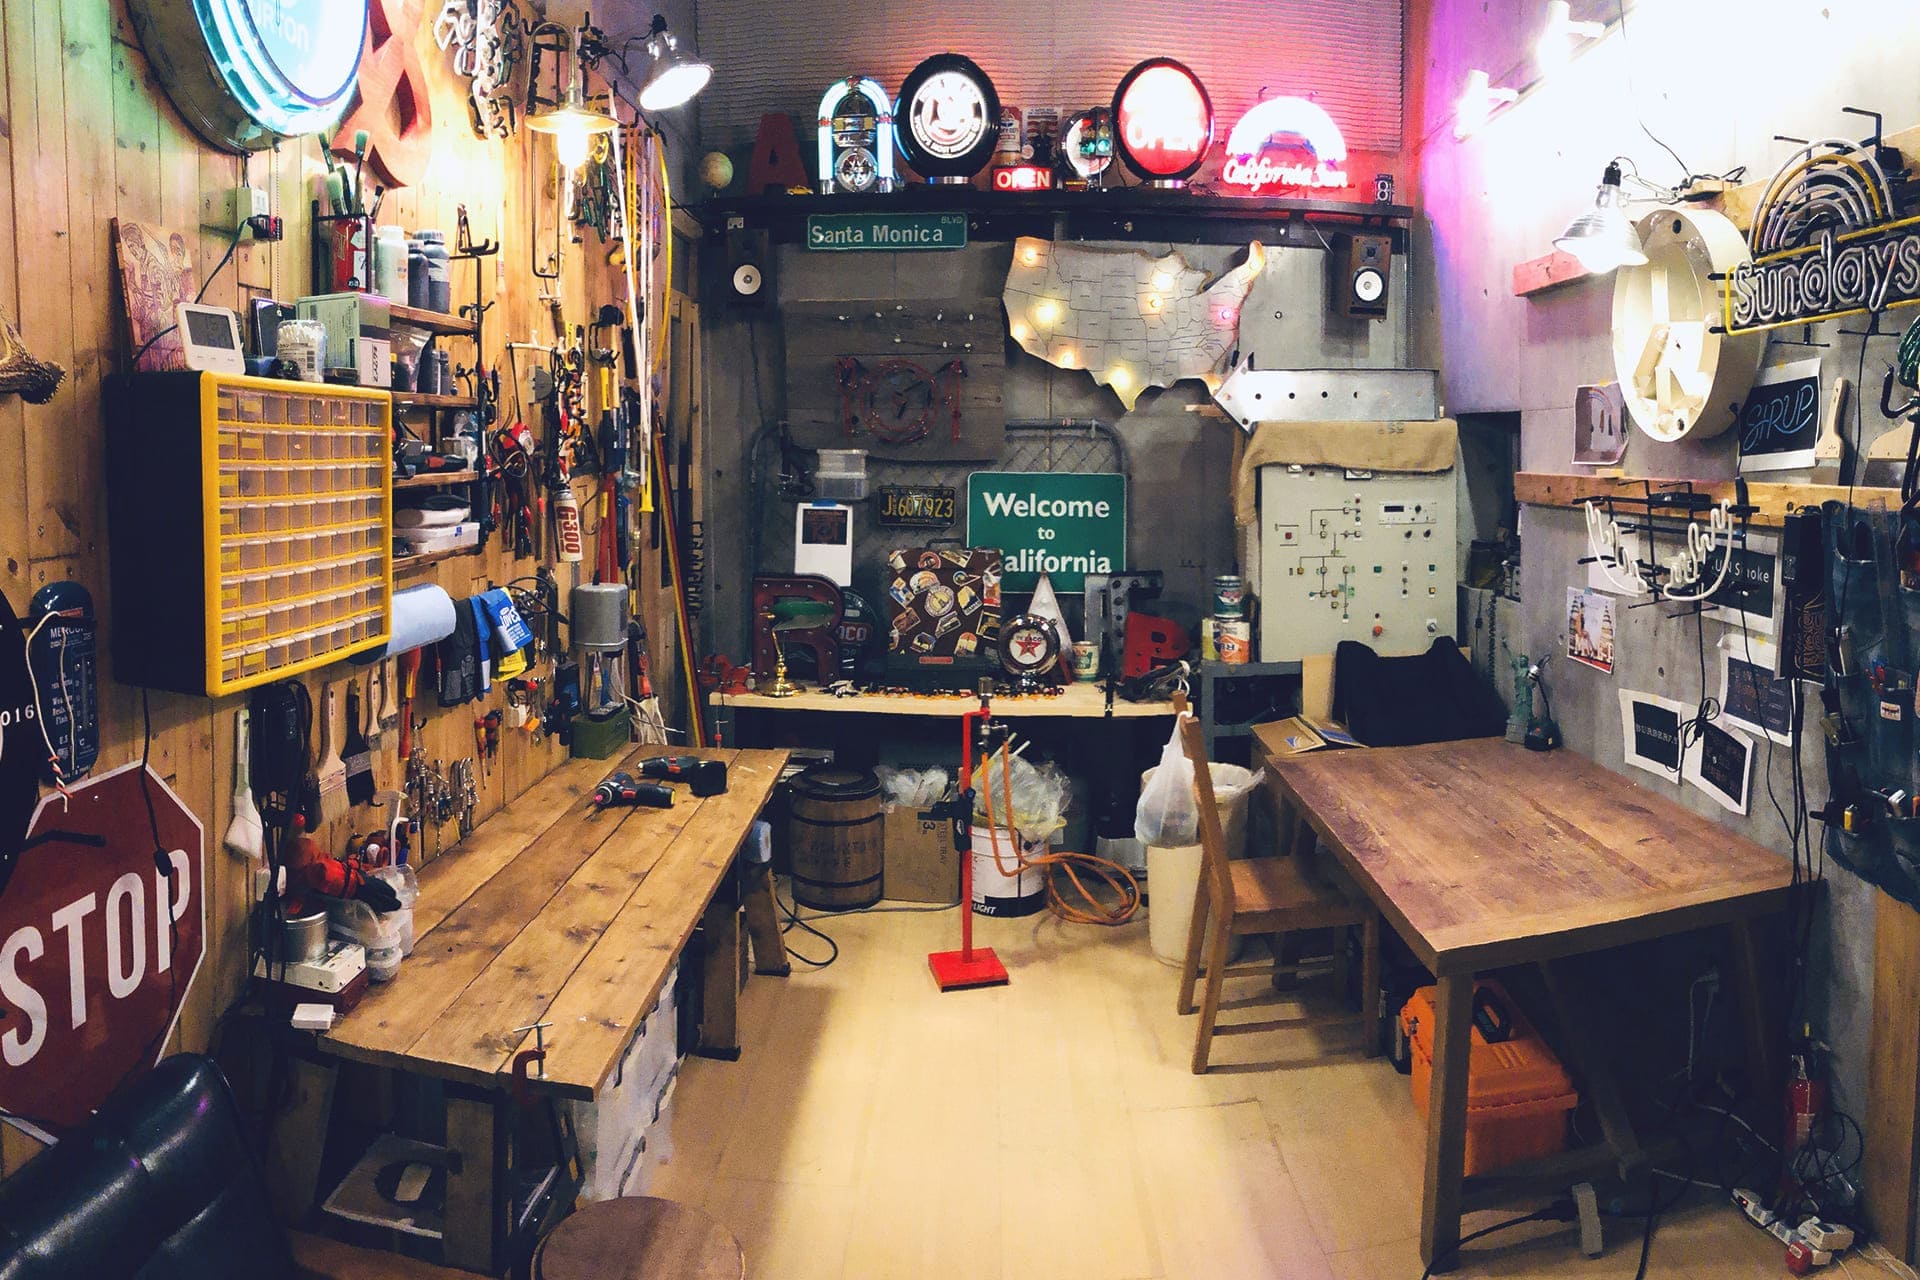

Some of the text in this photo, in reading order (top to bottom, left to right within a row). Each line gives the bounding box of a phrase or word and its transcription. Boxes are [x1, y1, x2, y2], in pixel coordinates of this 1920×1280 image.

[941, 216, 963, 224] BLVD
[811, 224, 943, 243] Santa Monica
[1735, 230, 1920, 325] Sundays
[983, 492, 1110, 518] Welcome
[557, 506, 581, 553] G300
[1037, 527, 1056, 540] to
[1000, 549, 1112, 574] alifornia
[1735, 562, 1769, 583] Soke
[0, 849, 191, 1067] STOP
